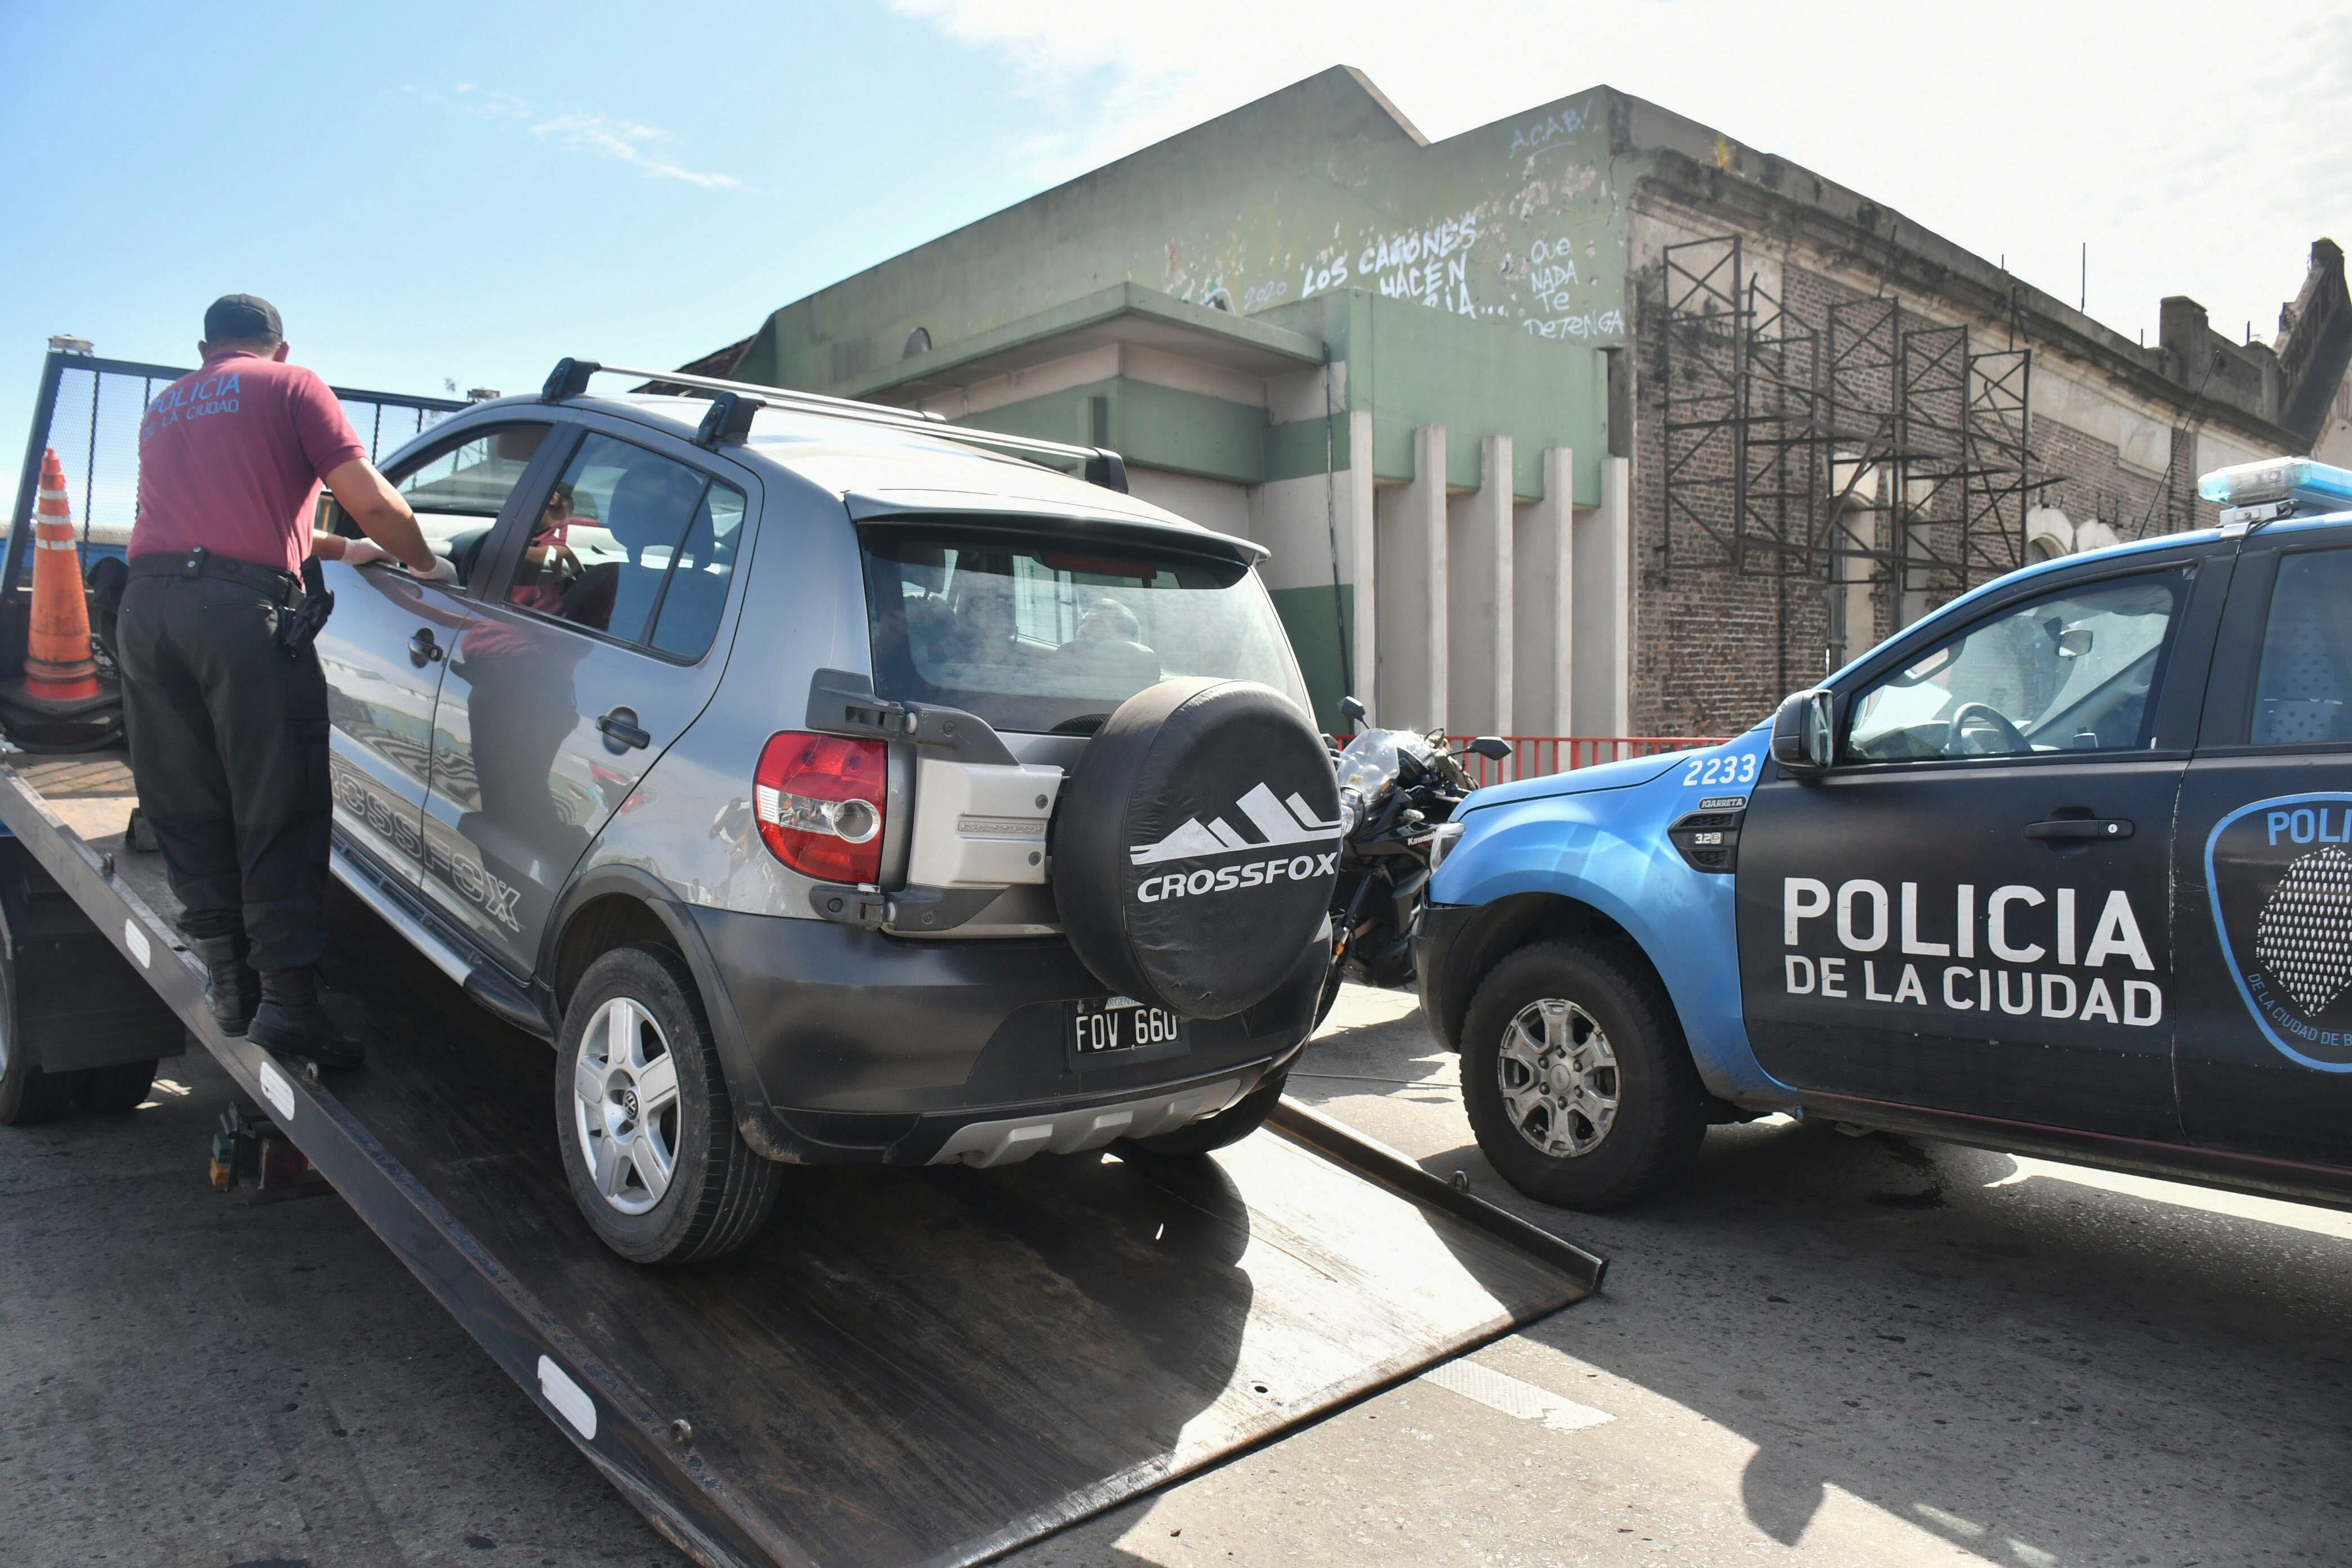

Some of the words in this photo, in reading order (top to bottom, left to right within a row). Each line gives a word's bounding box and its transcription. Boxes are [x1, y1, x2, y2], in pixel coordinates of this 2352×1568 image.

[1531, 259, 1579, 292] NADA
[144, 374, 240, 423] POLICIA
[162, 411, 177, 427] LA
[186, 399, 239, 420] CIUDAD
[1682, 754, 1756, 786] 2233
[1701, 798, 1743, 808] IGARRETA
[1137, 852, 1338, 903] CROSSFOX
[1784, 877, 2155, 970] POLICIA
[1785, 955, 1848, 998] DE
[1864, 960, 1927, 1005] LA
[1943, 966, 2162, 1027] CIUDAD
[2248, 973, 2265, 991] DE
[2257, 991, 2275, 1010] LA
[2272, 1007, 2318, 1041] CIUDAD
[2320, 1031, 2339, 1046] DE
[1076, 1012, 1118, 1052] FOV
[1135, 1008, 1177, 1044] 660
